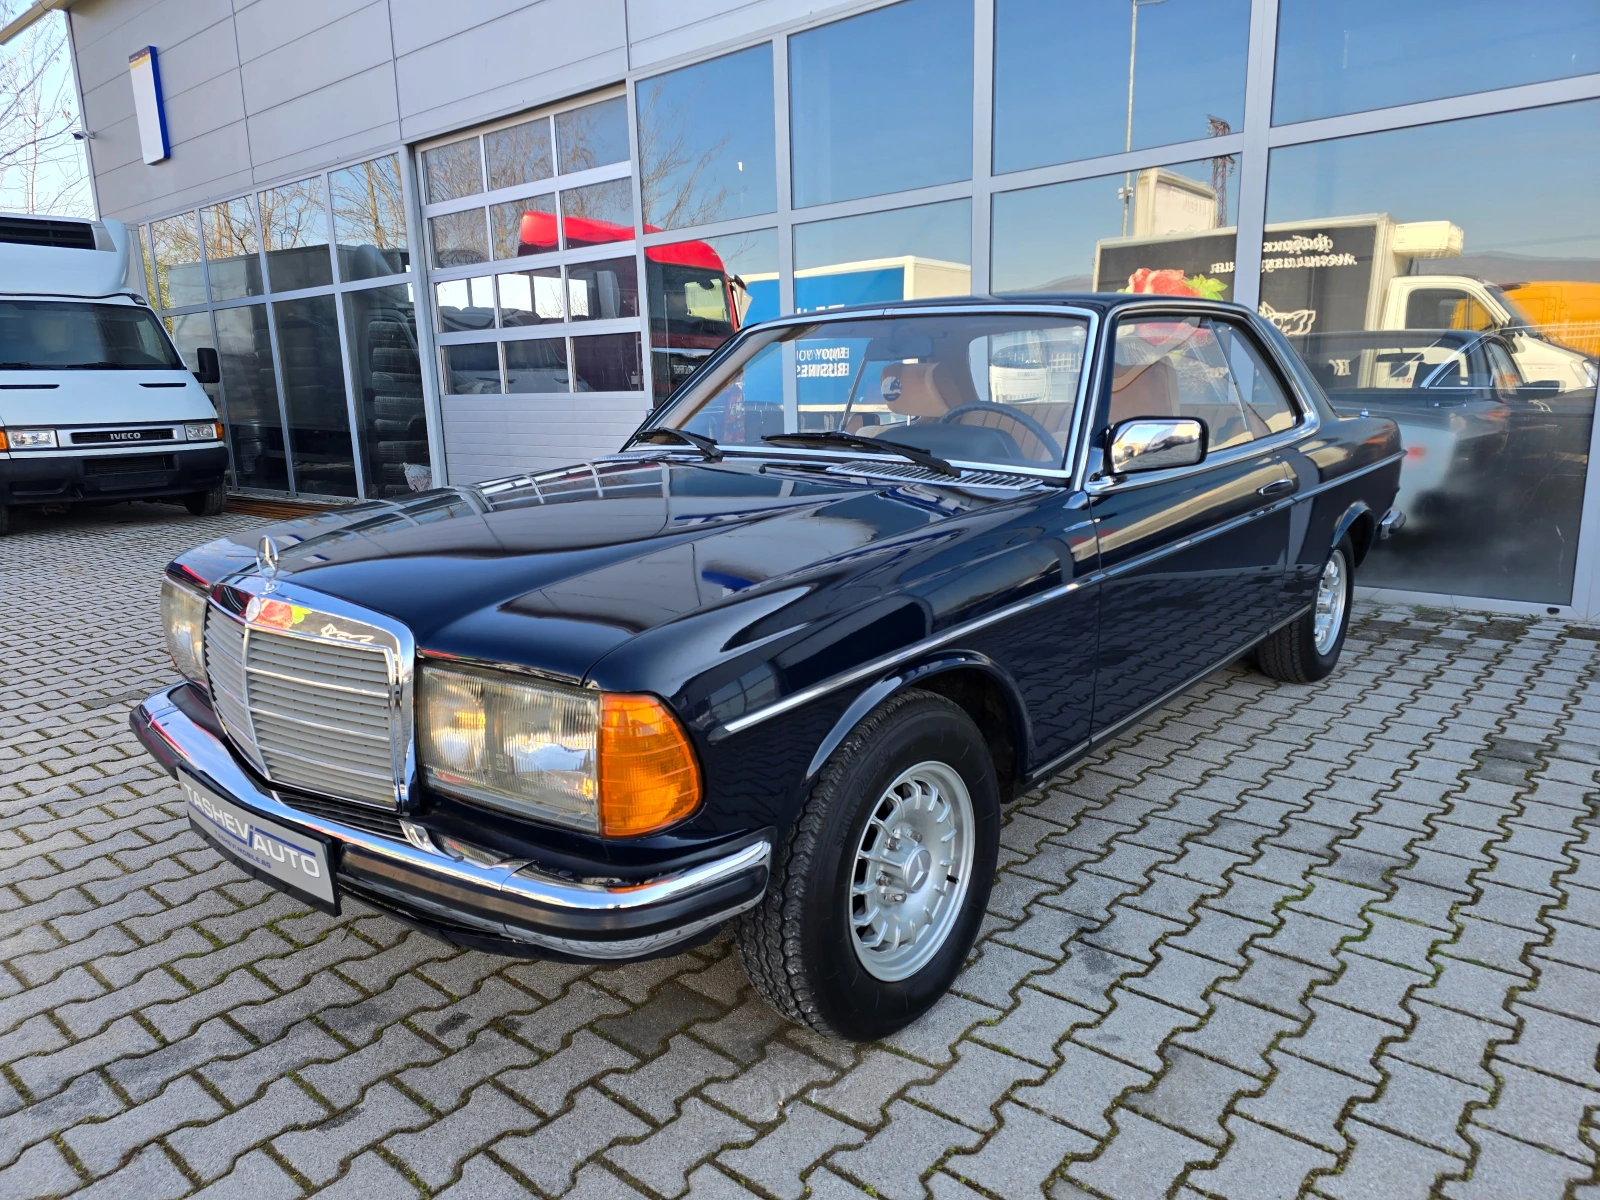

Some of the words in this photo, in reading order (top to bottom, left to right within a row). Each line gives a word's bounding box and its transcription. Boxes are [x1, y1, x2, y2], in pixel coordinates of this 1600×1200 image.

[109, 432, 141, 441] IVECO
[183, 782, 249, 840] TASHEV
[253, 833, 320, 878] AUTO
[834, 801, 858, 848] SPRINT
